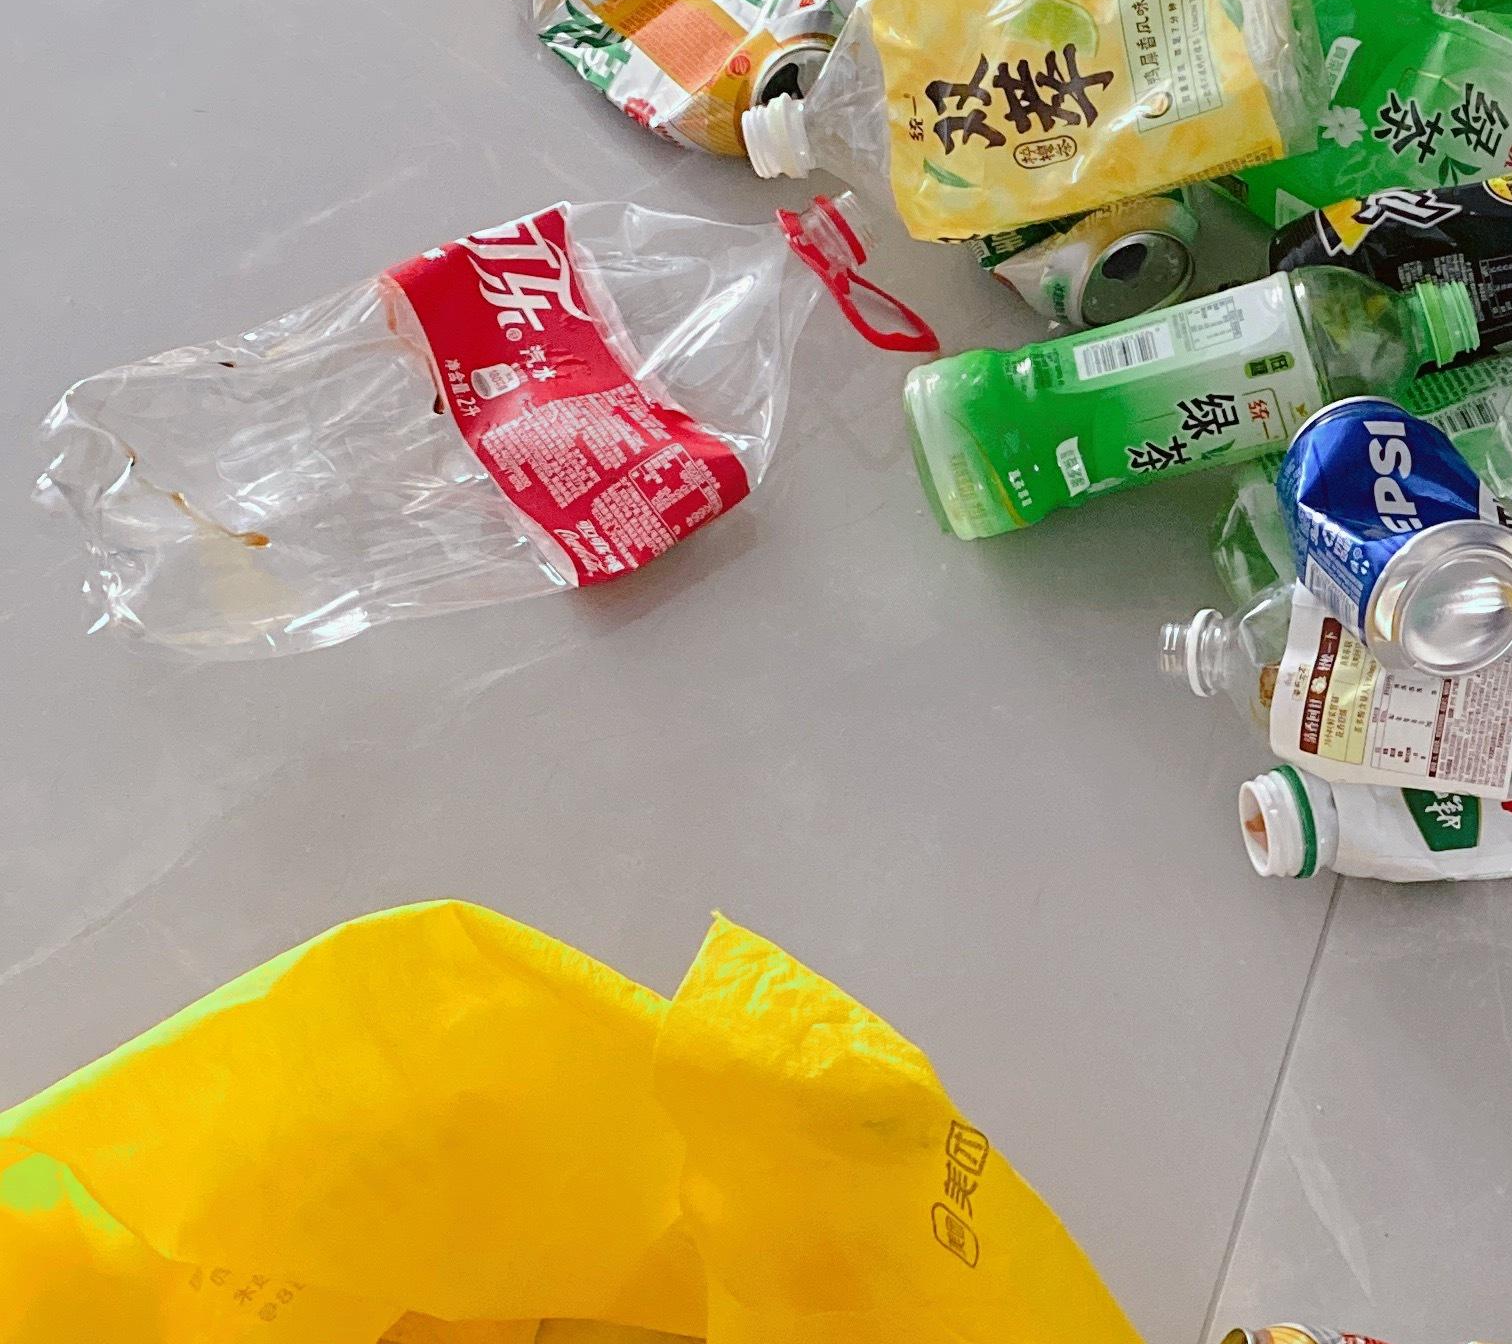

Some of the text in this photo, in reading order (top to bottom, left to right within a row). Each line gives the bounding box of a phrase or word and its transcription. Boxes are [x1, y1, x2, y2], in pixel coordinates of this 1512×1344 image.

[924, 43, 1114, 155] 双萃
[1374, 83, 1509, 164] 绿茶
[519, 343, 558, 382] 汽水
[1126, 393, 1242, 473] 绿茶
